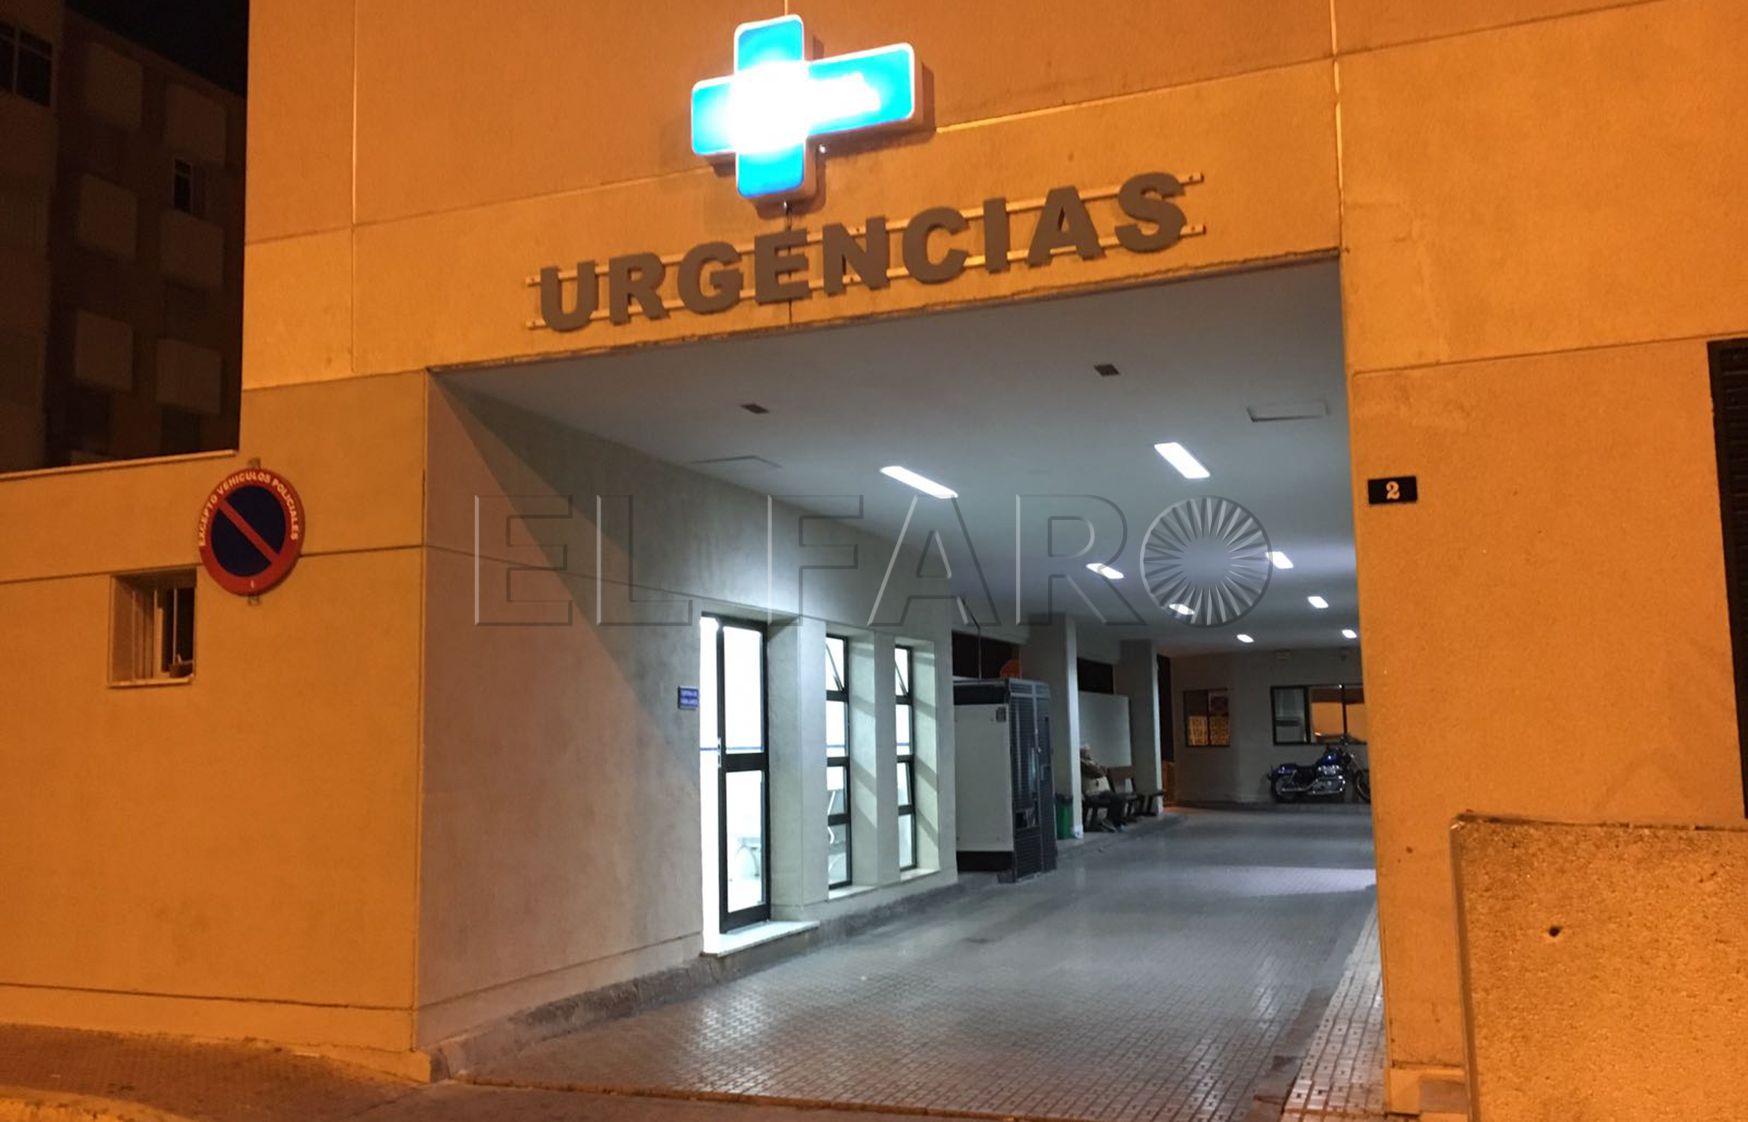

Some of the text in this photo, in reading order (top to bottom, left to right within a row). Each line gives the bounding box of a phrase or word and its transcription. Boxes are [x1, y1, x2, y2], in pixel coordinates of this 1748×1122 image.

[539, 172, 1187, 332] URGENCIAS
[217, 471, 271, 495] VEHICULOS
[272, 479, 299, 540] POLICIALES
[1386, 481, 1400, 500] 2
